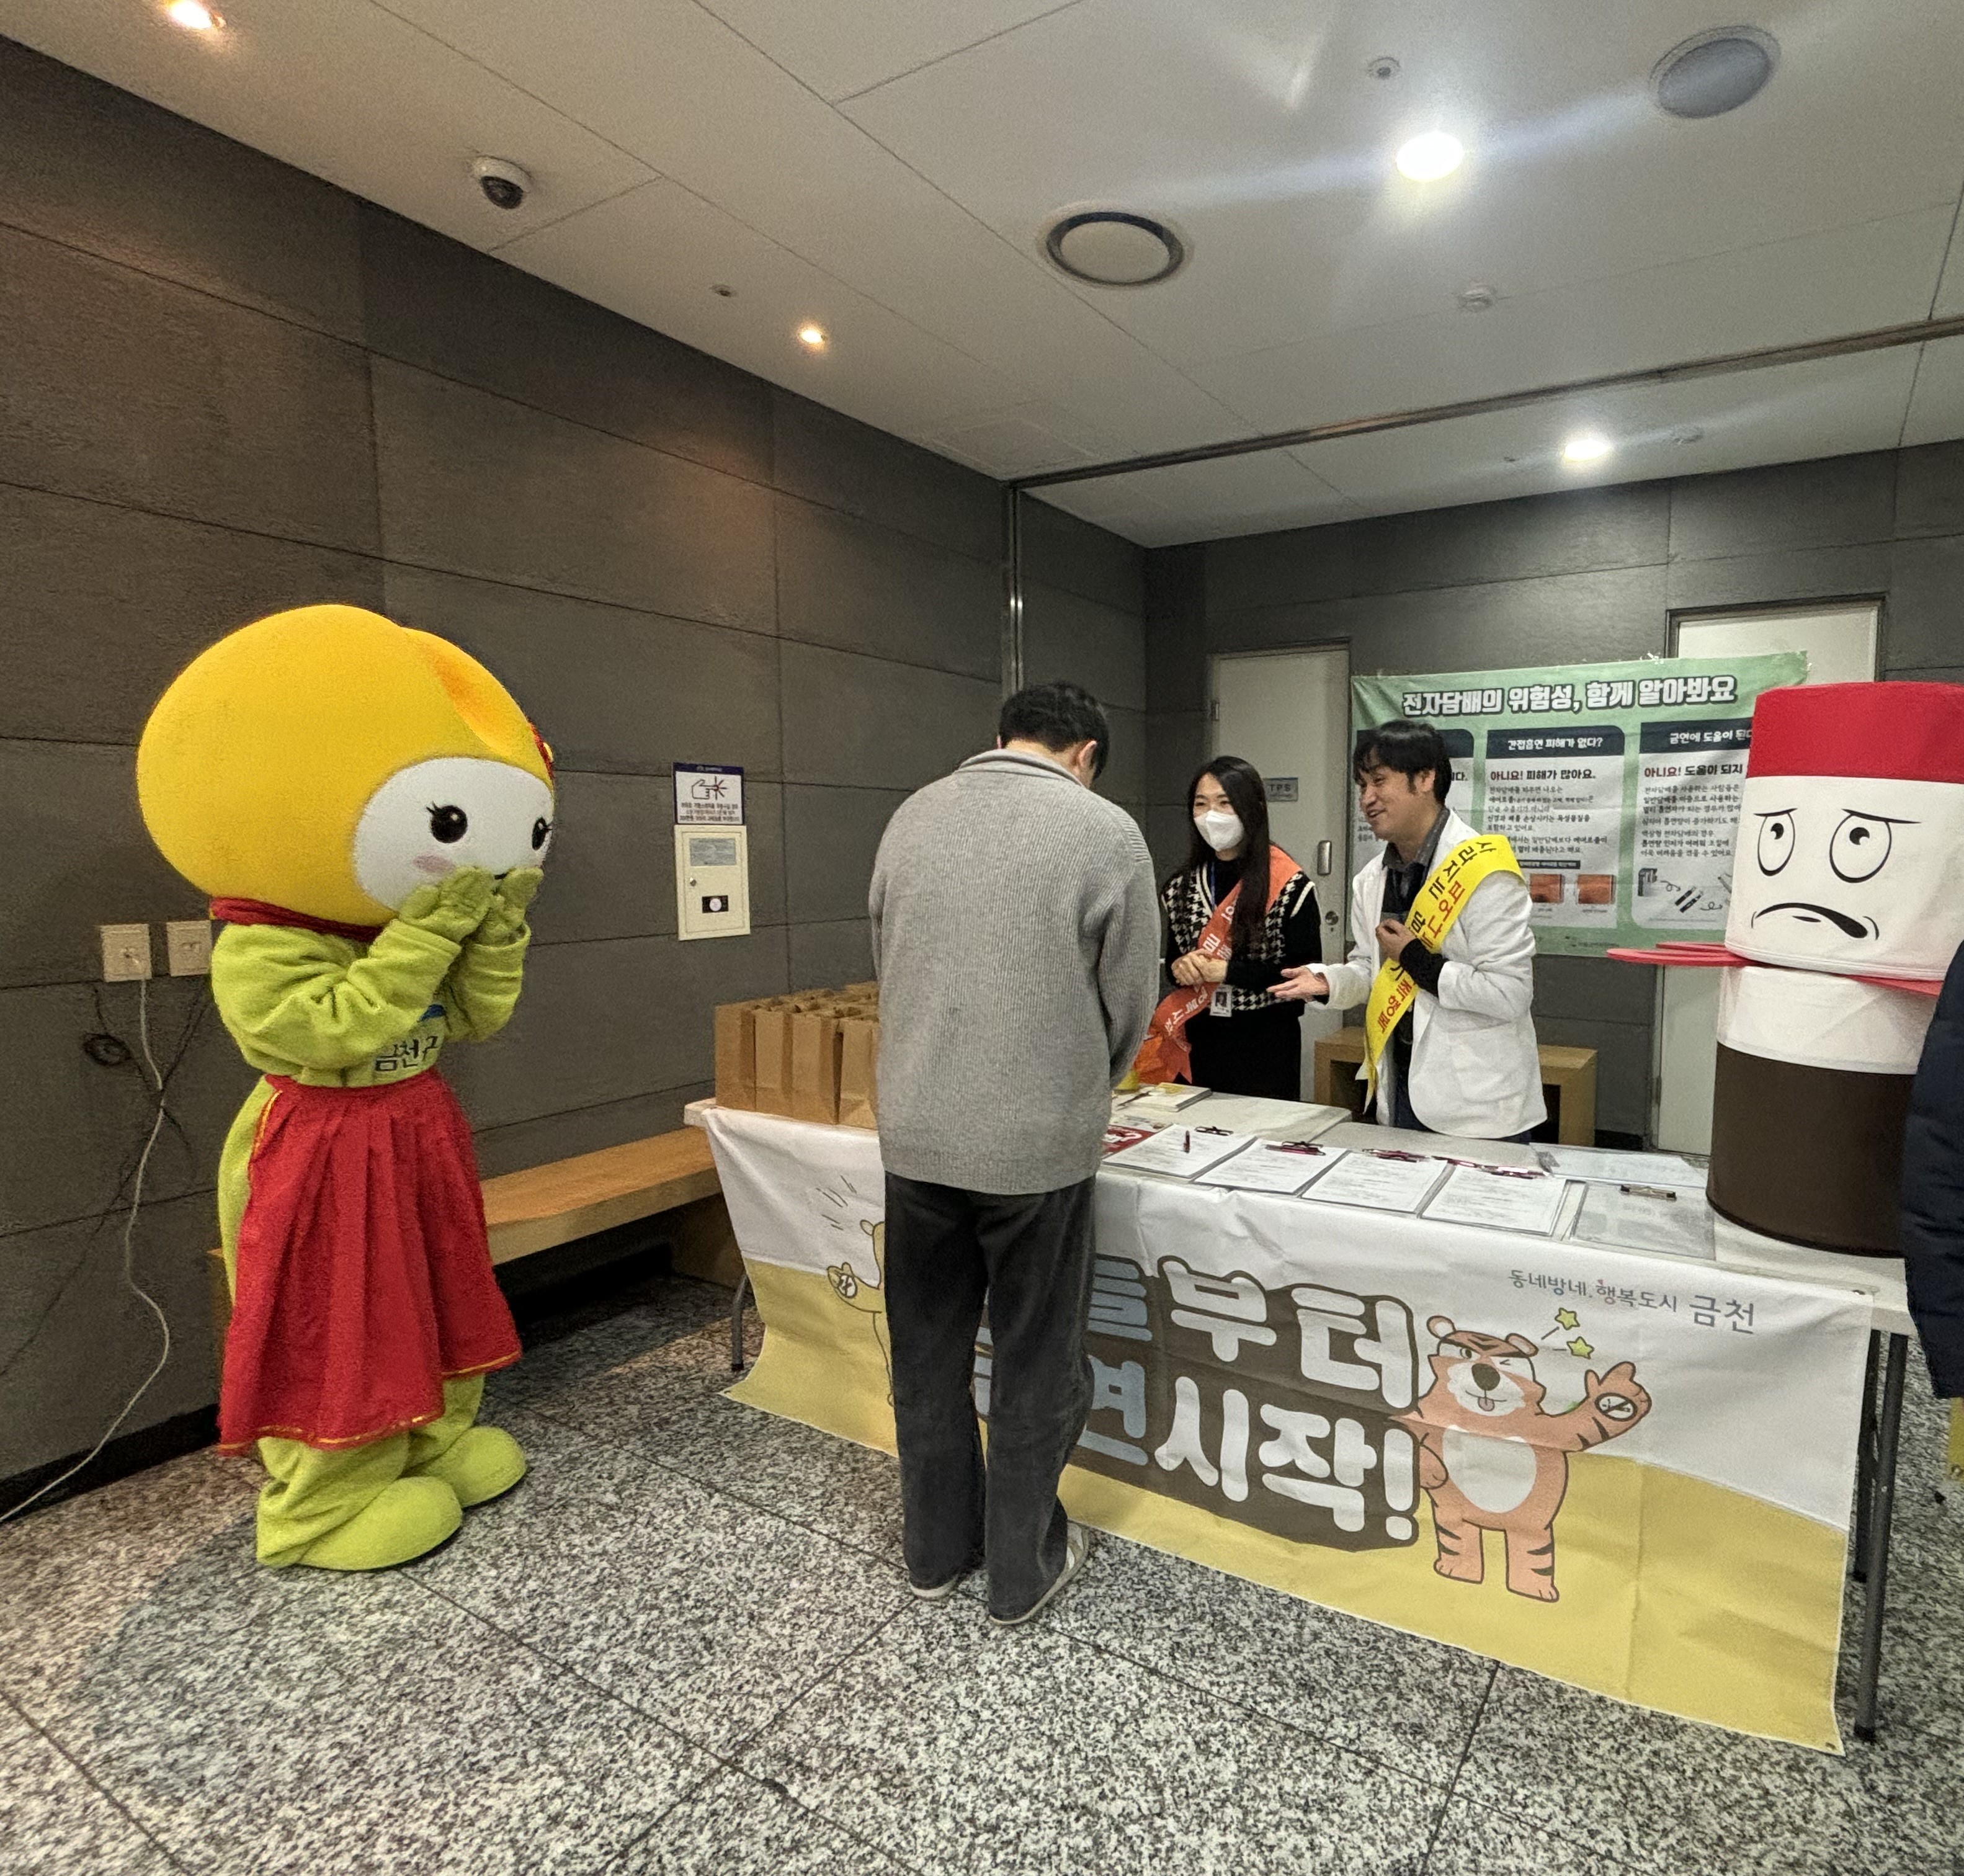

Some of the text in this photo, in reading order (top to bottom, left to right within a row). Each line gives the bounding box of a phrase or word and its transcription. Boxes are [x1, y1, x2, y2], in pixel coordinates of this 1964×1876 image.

[1403, 675, 1736, 717] 전자담배의 위험성, 함께 알아봐요
[1507, 736, 1604, 751] 간접흡연 피해가 없다?
[1669, 732, 1701, 745] 금연에
[1703, 730, 1733, 743] 도움이
[1490, 769, 1596, 781] 아니요! 피해가 많아요.
[1644, 763, 1743, 778] 아니요! 도움이 되지
[1267, 784, 1291, 792] TPS
[1428, 841, 1498, 901] 사라지는
[1508, 1269, 1755, 1335] 동네방네. 행복도시 금천
[1087, 1257, 1414, 1409] 늘부터
